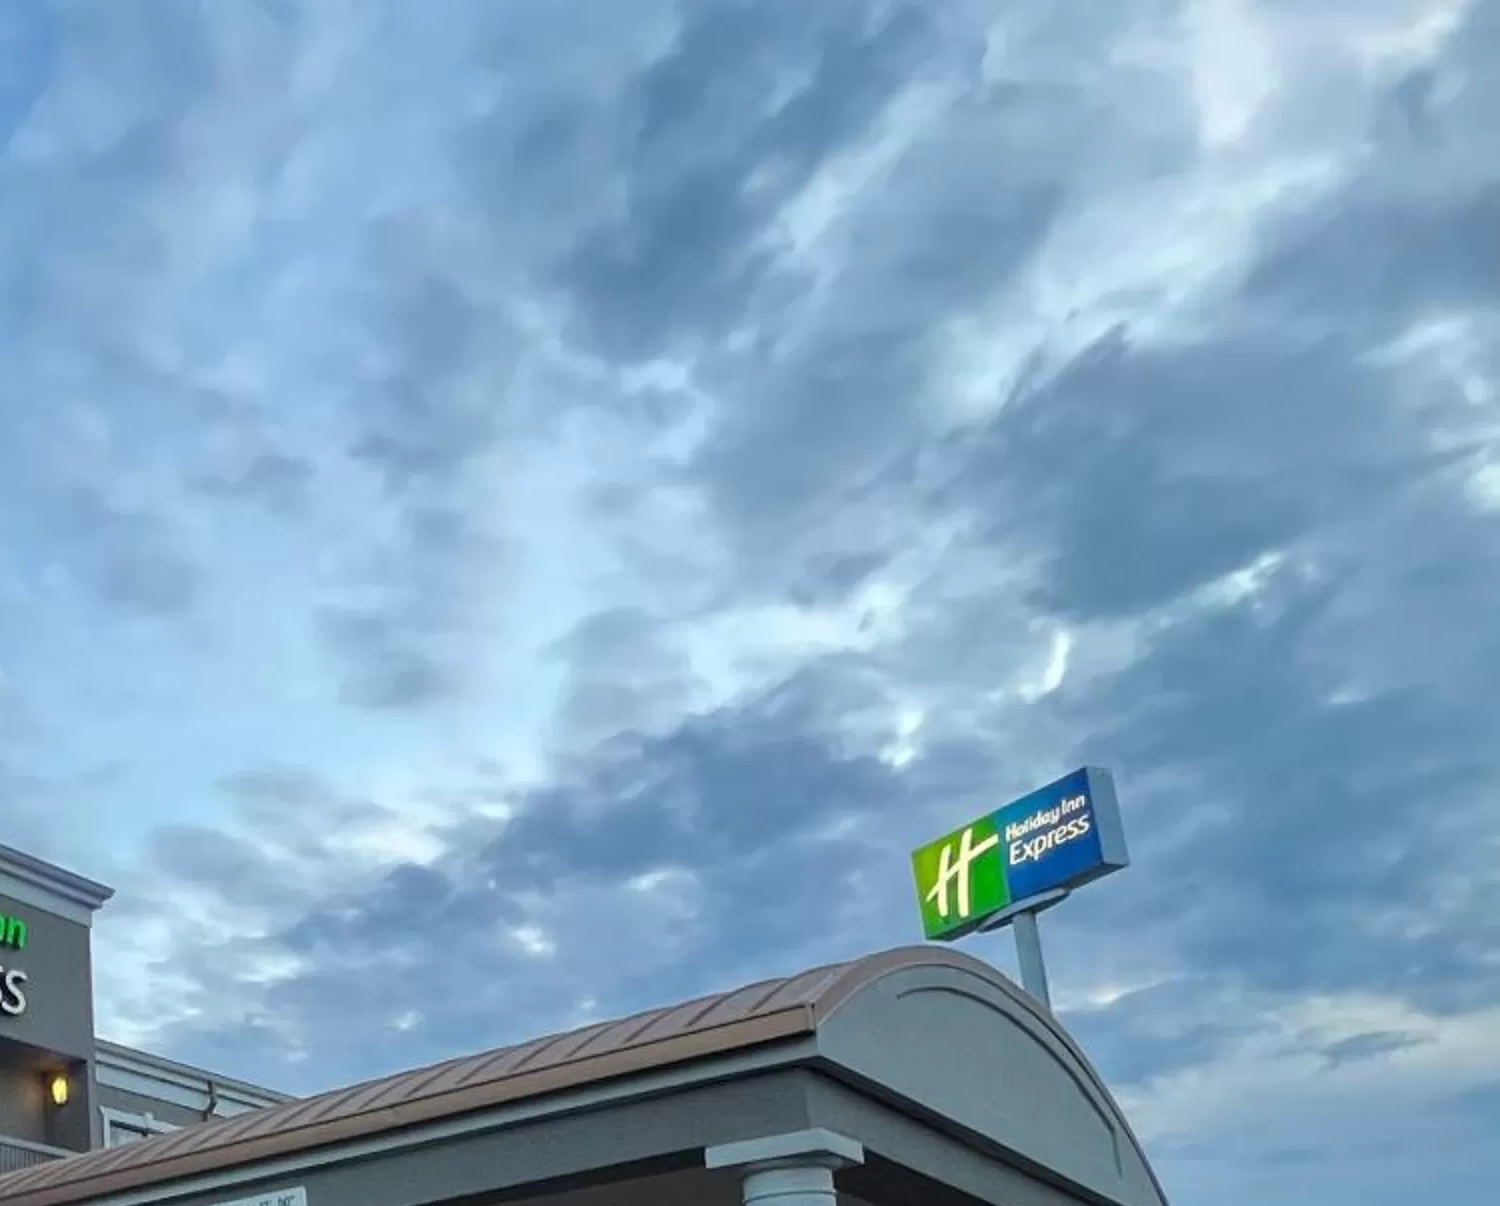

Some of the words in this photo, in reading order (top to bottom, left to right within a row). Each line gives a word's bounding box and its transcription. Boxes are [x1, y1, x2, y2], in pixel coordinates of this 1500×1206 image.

[1006, 806, 1061, 842] Holiday
[1061, 795, 1086, 813] Inn
[1009, 813, 1091, 865] Express
